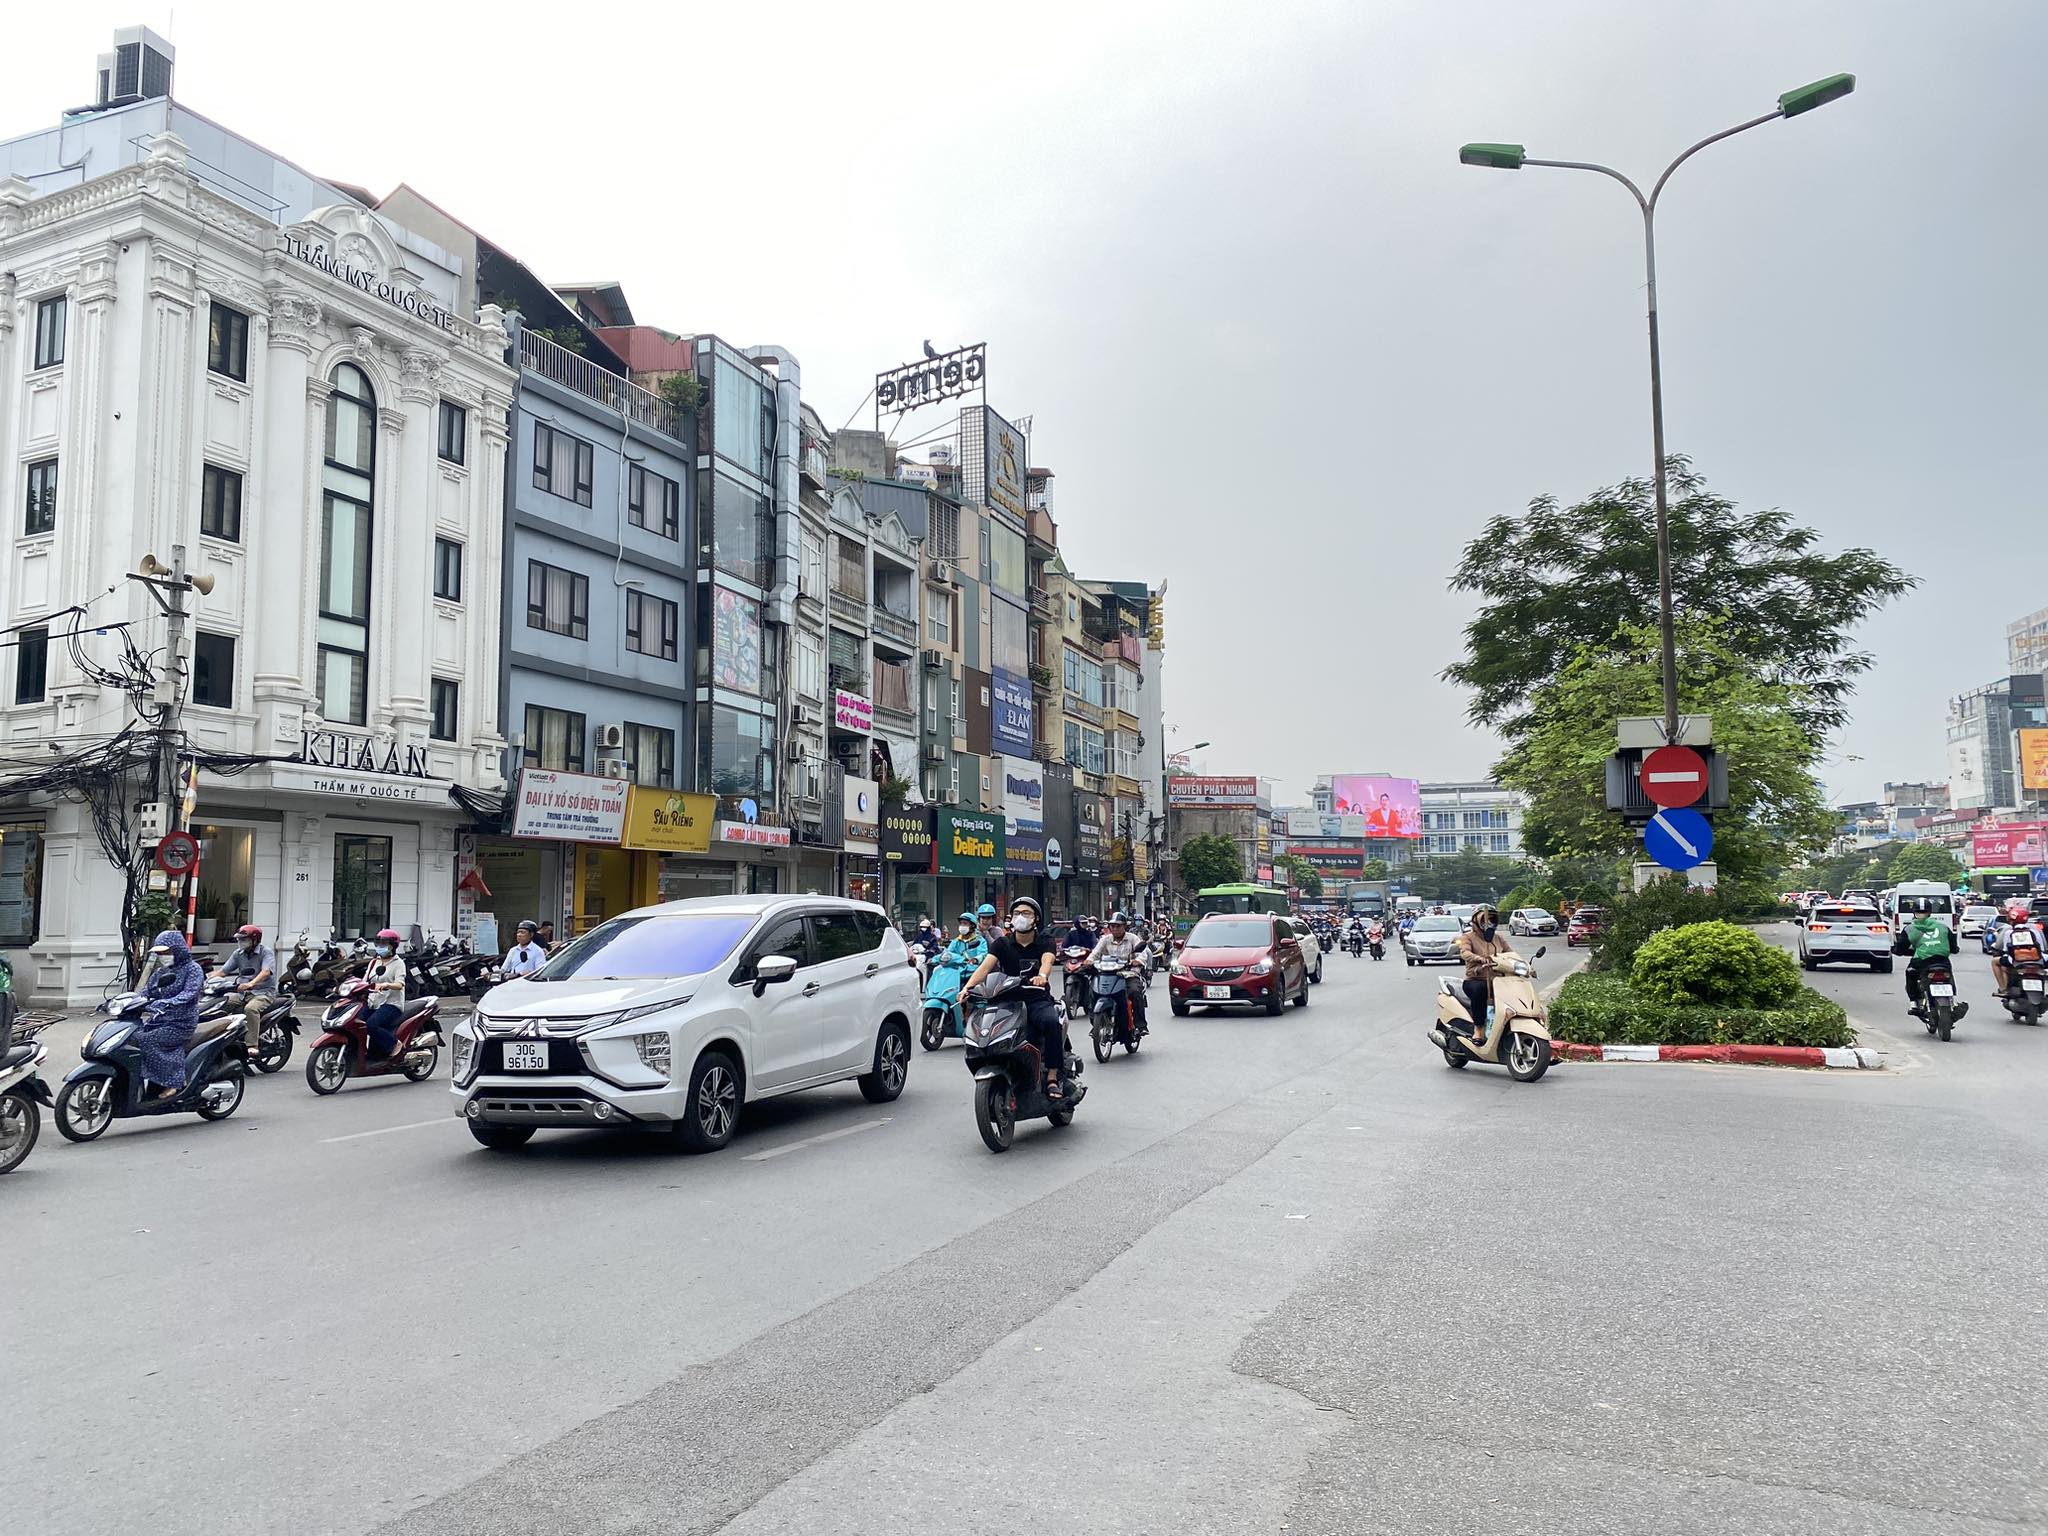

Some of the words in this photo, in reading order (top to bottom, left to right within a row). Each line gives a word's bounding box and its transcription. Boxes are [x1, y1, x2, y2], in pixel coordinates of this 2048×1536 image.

[378, 284, 430, 319] QUỐC
[300, 730, 428, 779] KHAAN
[313, 779, 345, 793] THẨM
[350, 783, 366, 794] MỸ
[370, 785, 400, 798] QUỐC
[404, 788, 418, 799] TẾ
[1204, 782, 1225, 795] PHÁT
[1226, 784, 1254, 796] NHANH
[526, 791, 540, 808] ĐẠI
[542, 790, 554, 806] LÝ
[568, 792, 580, 809] SỐ
[580, 795, 600, 813] ĐIỆN
[601, 797, 622, 814] TOÁN
[671, 810, 694, 828] RIÊNG
[953, 836, 994, 858] DeliFruit
[1310, 857, 1323, 865] Shop
[295, 872, 309, 881] 261
[515, 1044, 536, 1056] 30G
[508, 1057, 544, 1069] 961.50
